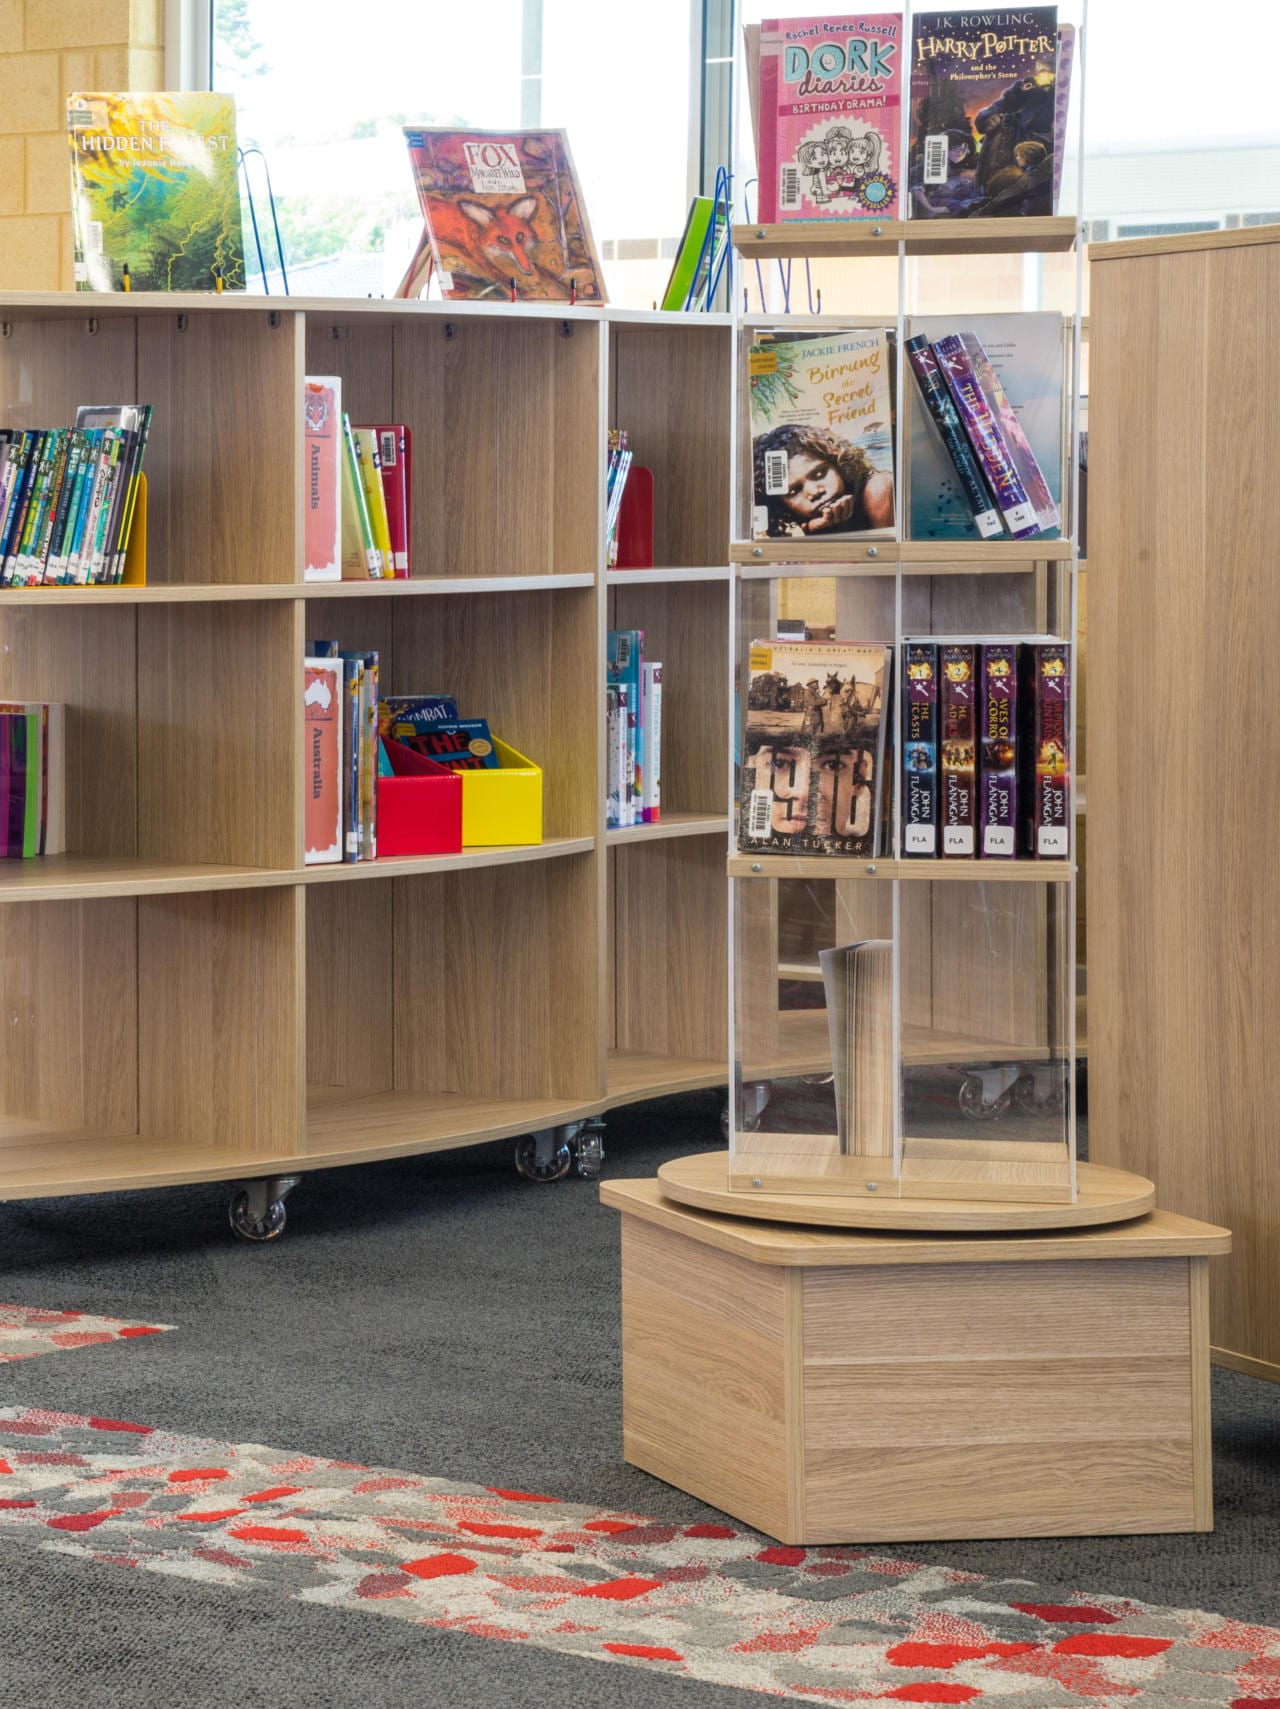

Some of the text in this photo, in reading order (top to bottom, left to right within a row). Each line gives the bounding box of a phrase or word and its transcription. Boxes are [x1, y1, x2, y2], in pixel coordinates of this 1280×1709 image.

[785, 22, 896, 40] Rachel Renée Russell
[960, 13, 1034, 27] ROWLING
[785, 38, 895, 82] DORK
[916, 32, 1055, 61] HARRY POTTER
[950, 72, 996, 81] Philosopher's
[985, 63, 997, 71] the
[799, 70, 883, 96] diaries
[792, 96, 886, 114] BIRTHDAY DRAMA!
[81, 136, 154, 151] HIDDEN
[466, 144, 518, 168] FOX
[119, 159, 131, 168] by
[802, 339, 879, 359] JACKIE FRENCH
[807, 351, 880, 385] Birrung
[822, 382, 872, 409] Secret
[960, 382, 979, 412] THE
[828, 399, 876, 425] Friend
[969, 411, 1017, 490] HIDDEN
[311, 444, 321, 510] Animals
[955, 668, 961, 676] 2
[911, 703, 919, 740] TCASTS
[921, 703, 930, 721] THE
[949, 704, 957, 738] ADERS
[959, 706, 967, 719] HE
[989, 690, 998, 740] CORRO
[999, 698, 1008, 740] AVES OF
[1043, 699, 1052, 738] UNTAIN
[410, 733, 467, 756] THE
[312, 727, 323, 799] Australia
[920, 789, 930, 818] JOHN
[959, 788, 968, 817] JOHN
[999, 788, 1008, 817] JOHN
[1052, 788, 1063, 817] JOHN
[751, 836, 863, 851] ALAN TUCKER
